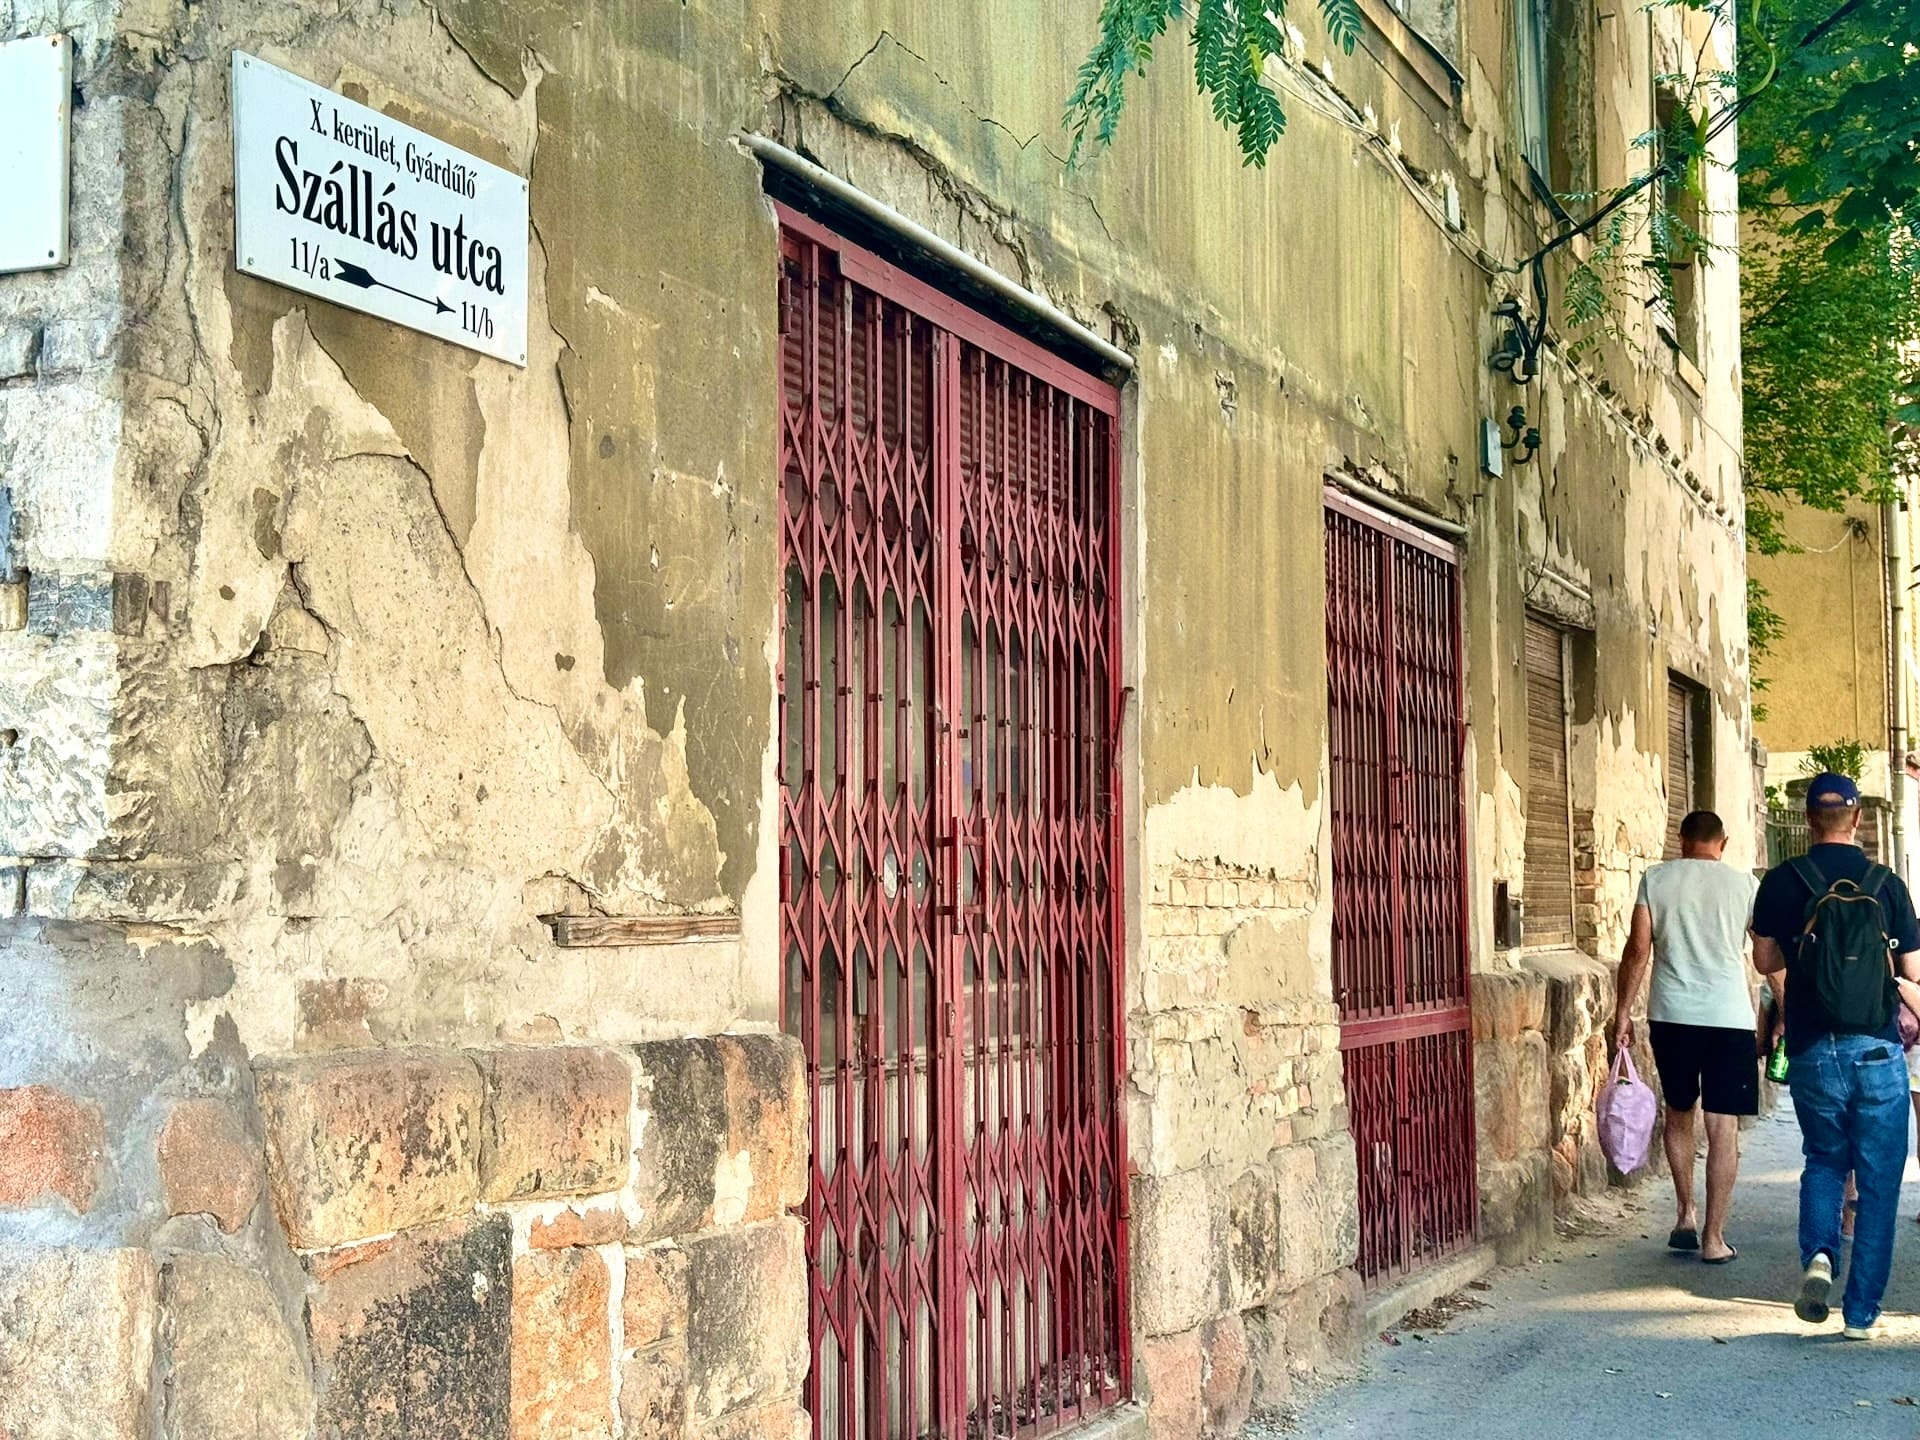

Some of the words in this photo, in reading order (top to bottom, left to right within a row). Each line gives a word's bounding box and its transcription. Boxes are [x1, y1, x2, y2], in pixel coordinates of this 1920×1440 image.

[309, 97, 327, 136] X.
[333, 108, 400, 173] kerület,
[404, 142, 478, 200] Gyárdűlő
[275, 136, 418, 260] Szállás
[430, 213, 505, 296] utca
[290, 236, 331, 281] 11/a
[460, 301, 494, 340] 11/b
